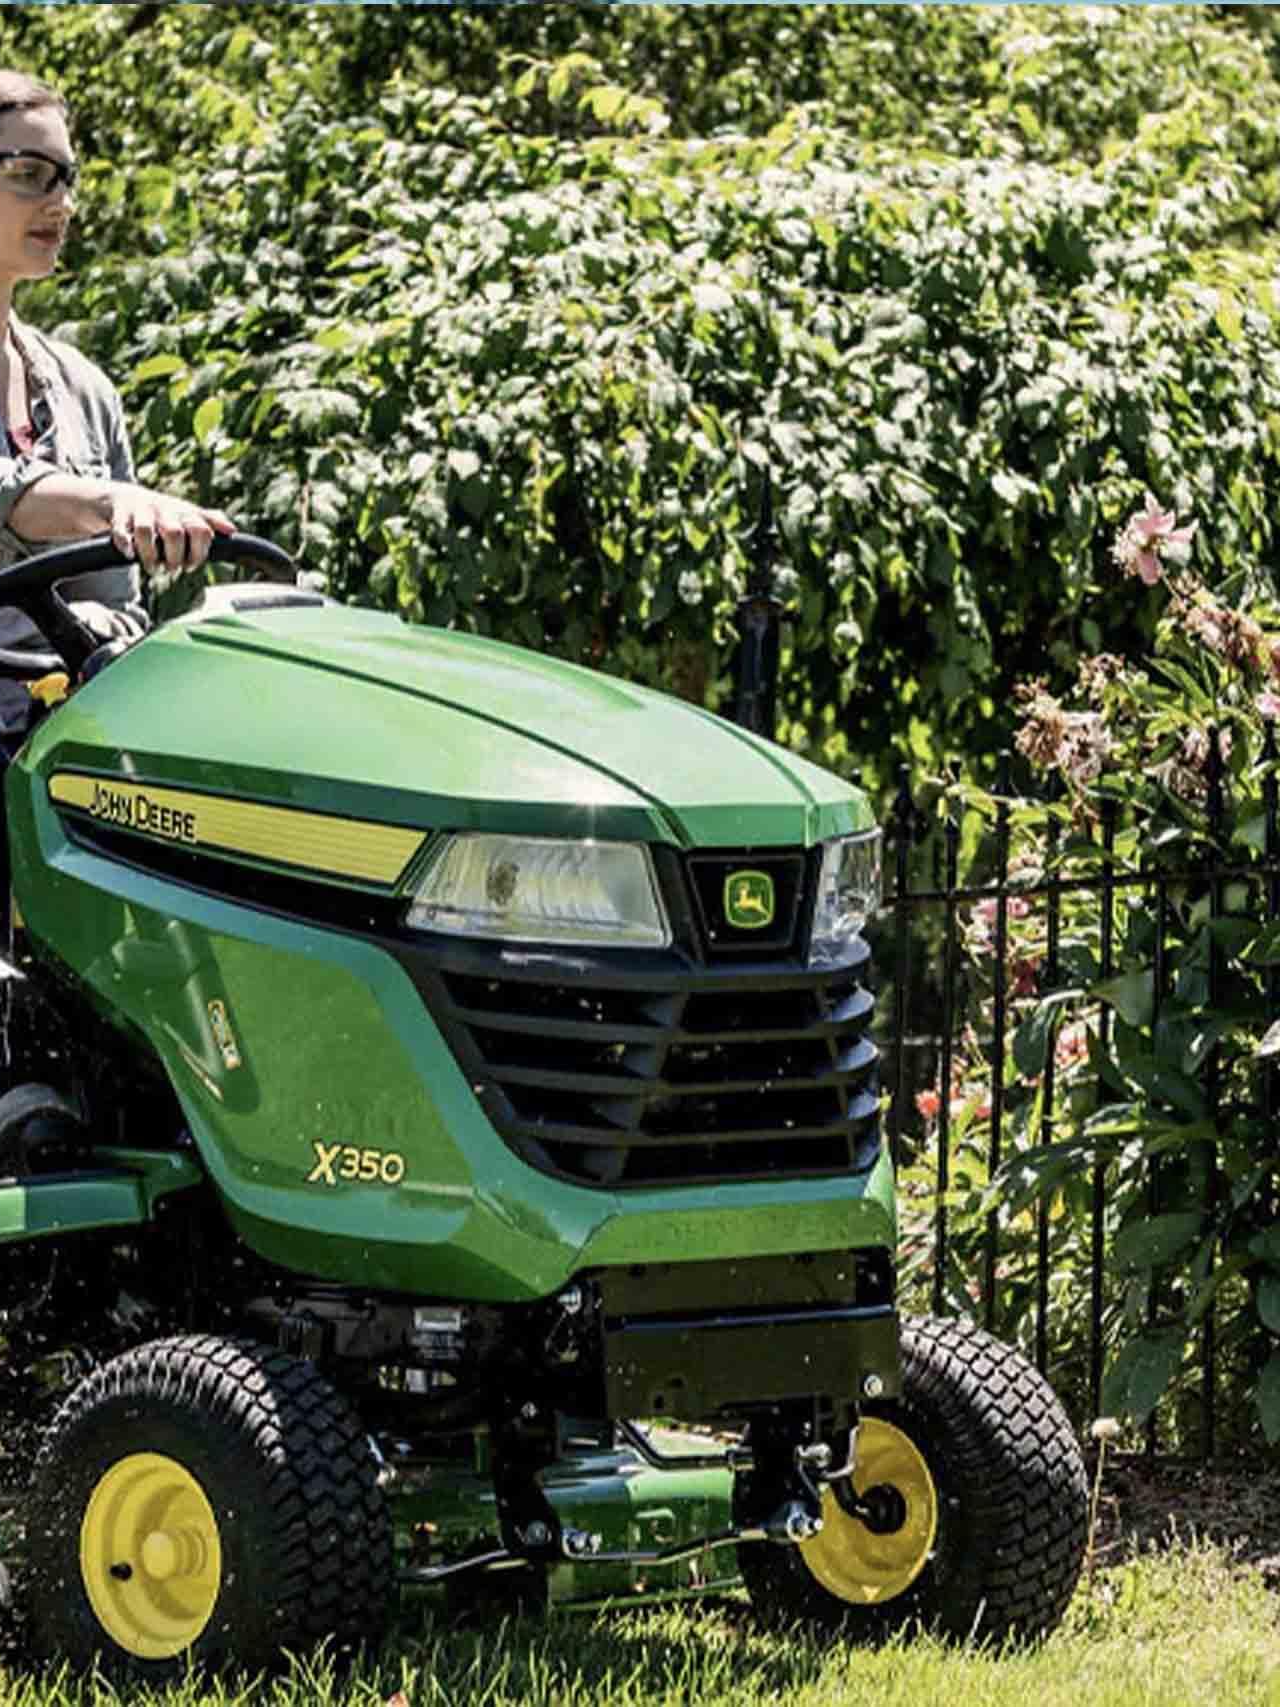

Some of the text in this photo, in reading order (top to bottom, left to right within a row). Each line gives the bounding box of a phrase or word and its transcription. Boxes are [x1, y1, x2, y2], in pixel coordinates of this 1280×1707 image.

[89, 783, 197, 840] JOHN DEERE
[307, 1140, 405, 1186] X350
